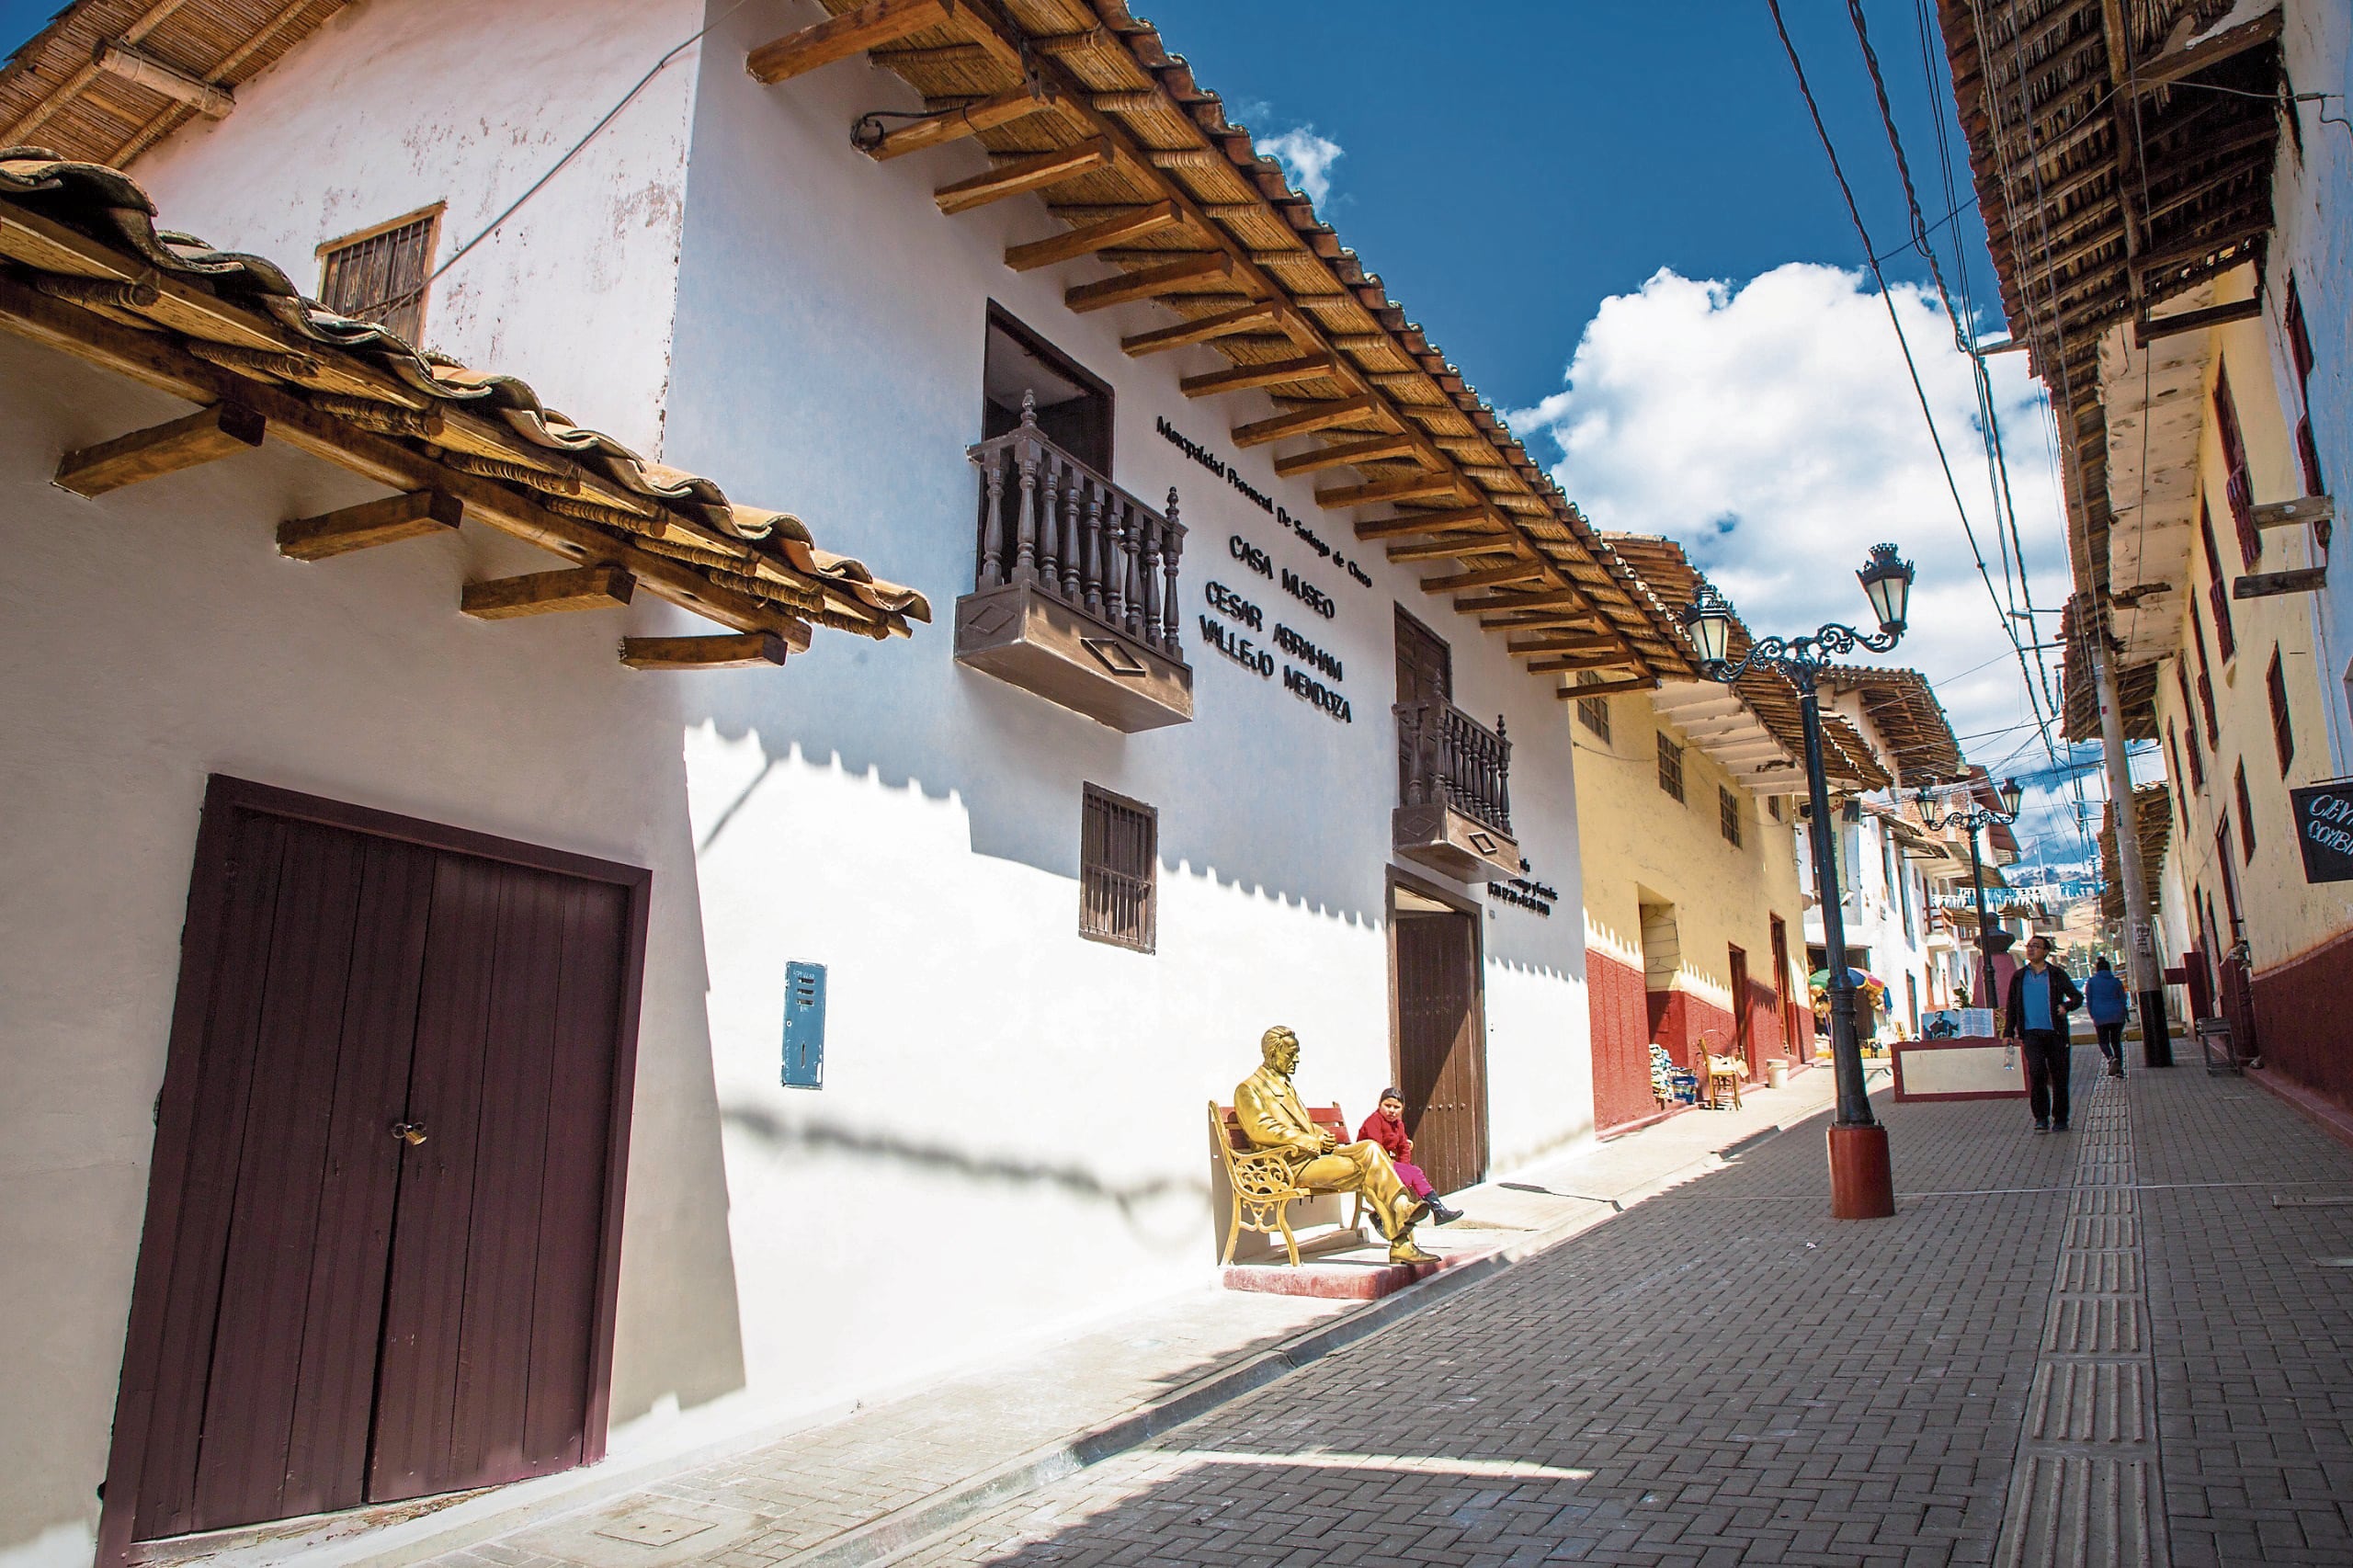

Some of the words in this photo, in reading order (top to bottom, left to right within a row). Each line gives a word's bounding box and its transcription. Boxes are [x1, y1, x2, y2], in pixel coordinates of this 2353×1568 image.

[1229, 535, 1274, 580] CASA
[1282, 568, 1335, 619] MUSEO
[1199, 614, 1274, 677] VALLEJO
[1283, 665, 1352, 723] MENDOZA
[1205, 581, 1263, 632] CESAR
[1272, 623, 1343, 682] ABRAHAM
